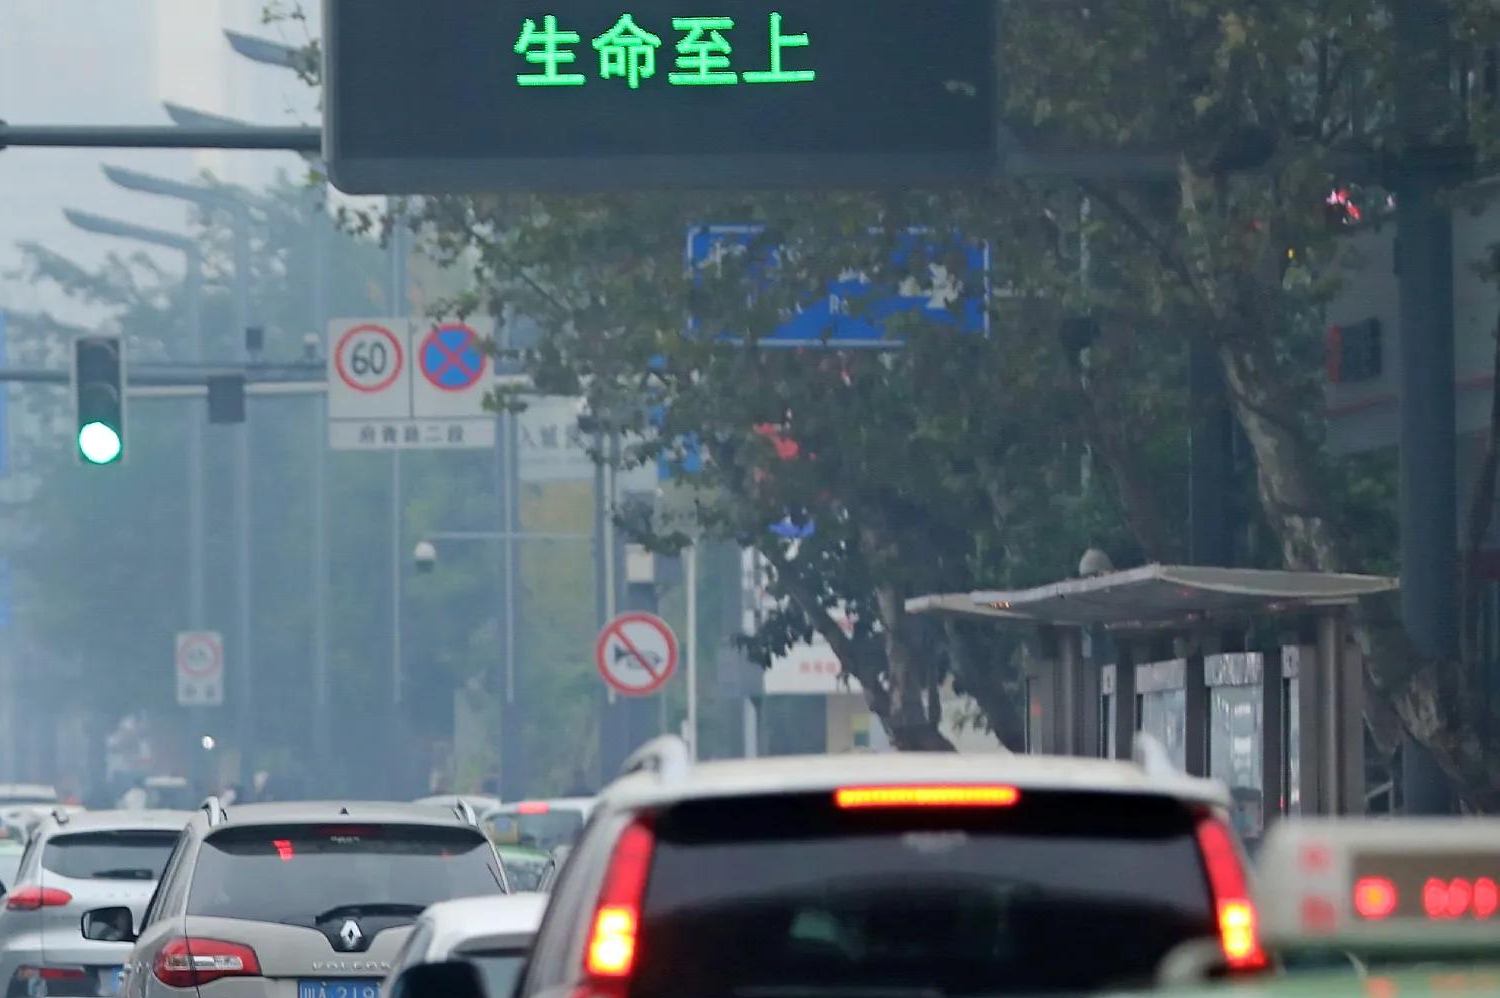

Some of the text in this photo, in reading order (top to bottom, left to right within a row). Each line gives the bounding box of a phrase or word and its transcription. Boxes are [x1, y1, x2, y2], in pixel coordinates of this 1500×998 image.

[514, 12, 816, 89] 生命至上
[351, 341, 387, 376] 60
